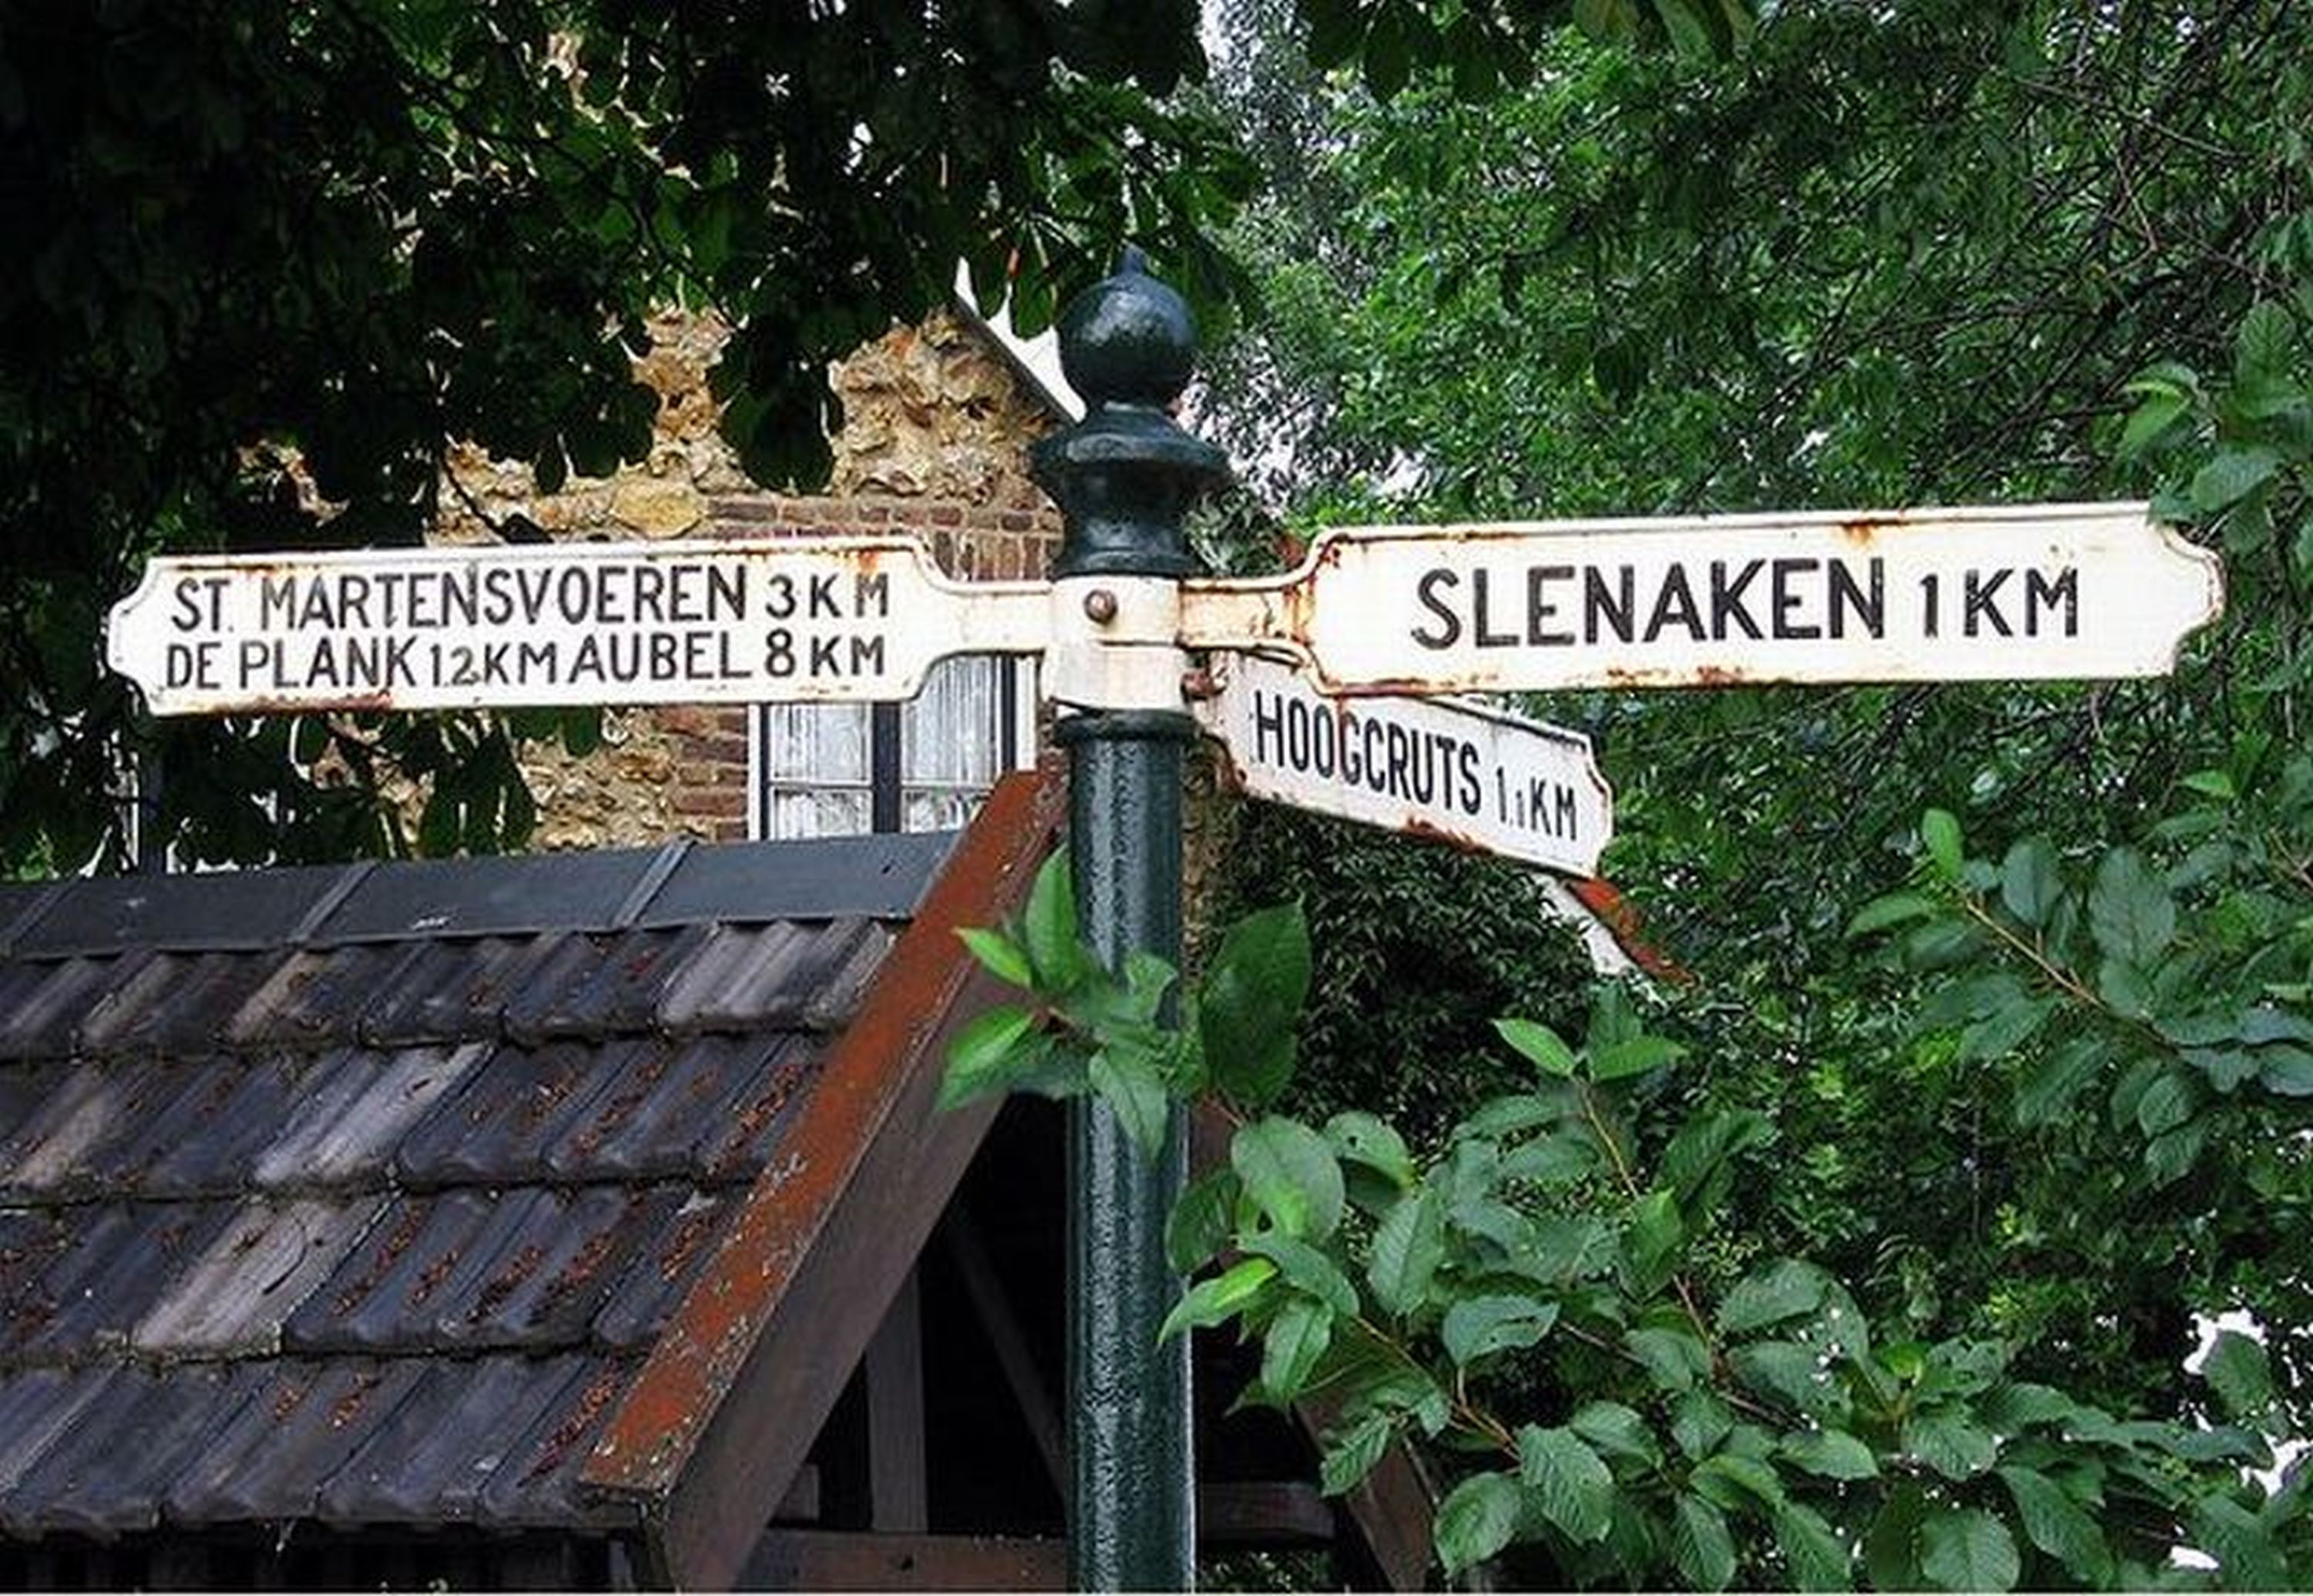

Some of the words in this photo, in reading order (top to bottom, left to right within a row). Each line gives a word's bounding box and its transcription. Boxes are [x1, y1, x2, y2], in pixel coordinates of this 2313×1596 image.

[261, 564, 747, 630] MARTENSVOEREN
[1409, 557, 1885, 651] SLENAKEN
[166, 641, 222, 690] DE
[239, 635, 418, 689] PLANK
[567, 630, 752, 685] AUBEL
[1254, 689, 1482, 816] HOOGCRUTS
